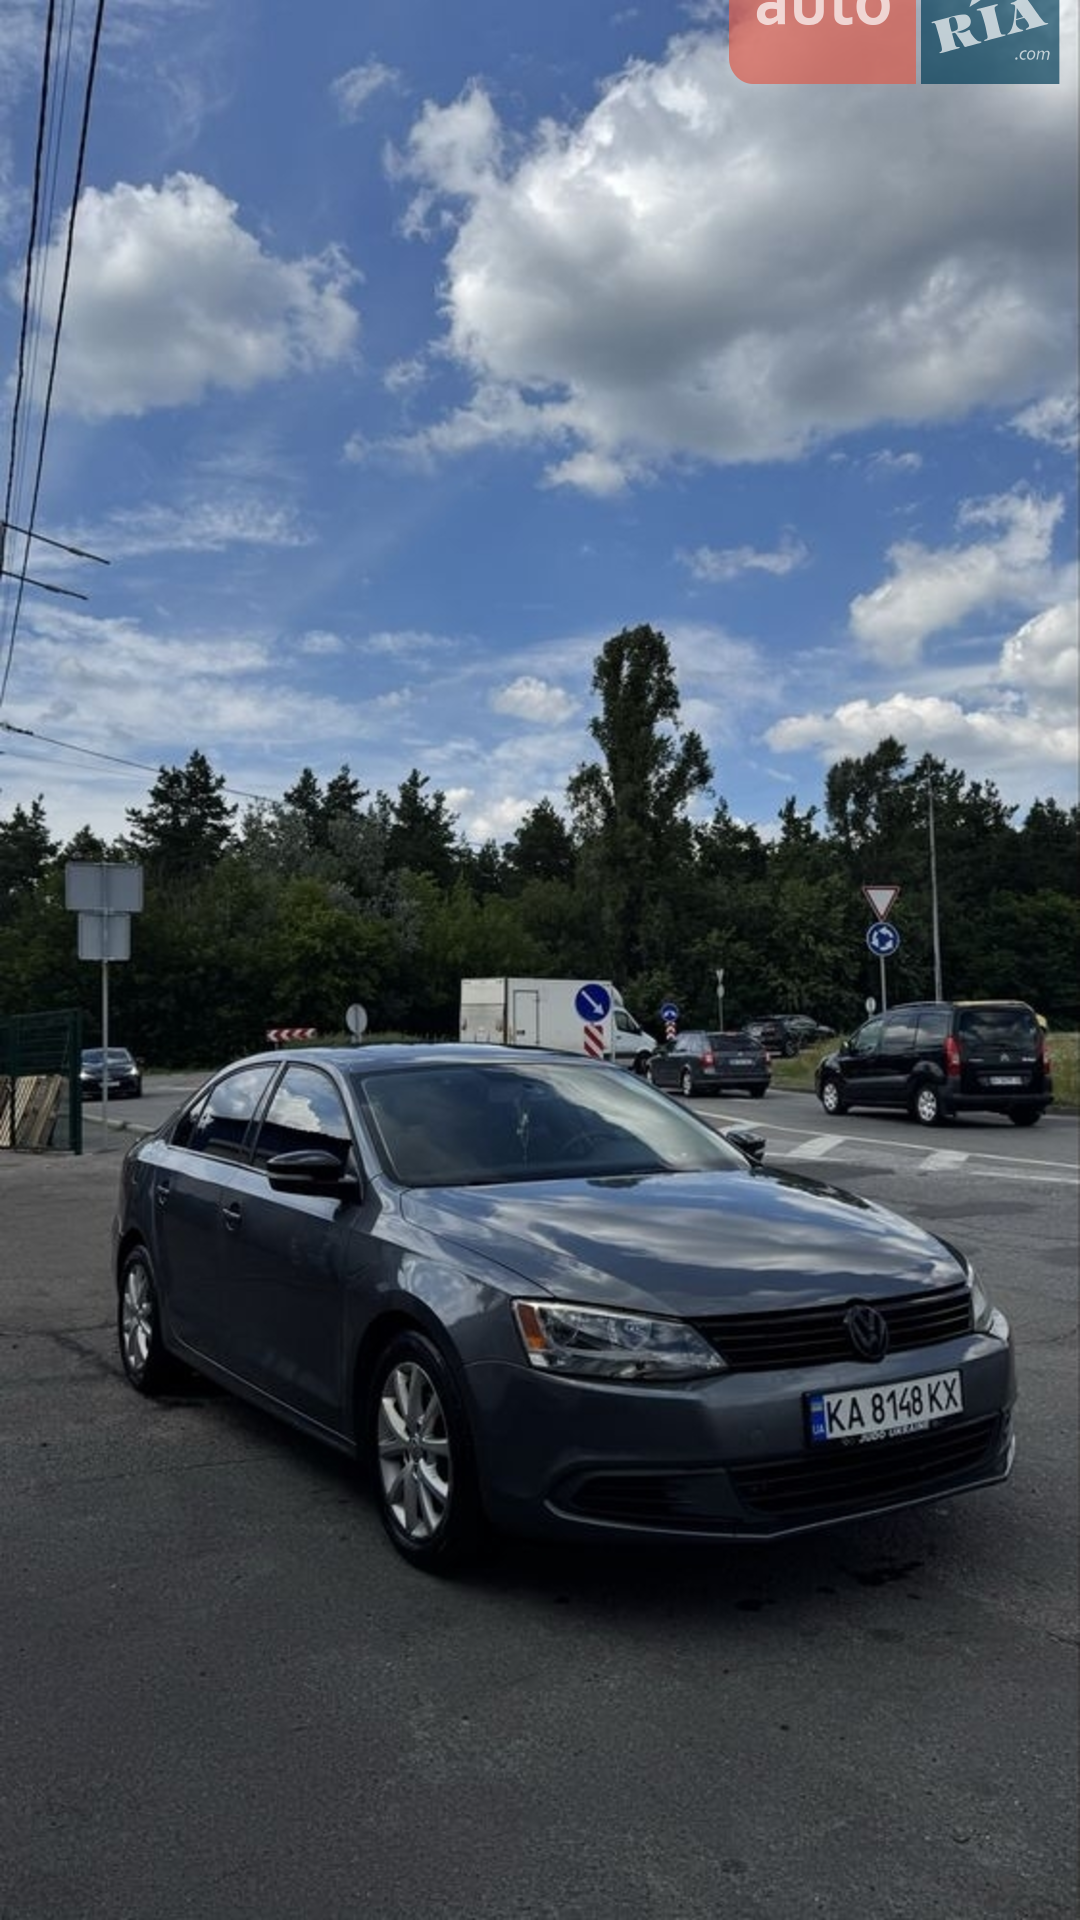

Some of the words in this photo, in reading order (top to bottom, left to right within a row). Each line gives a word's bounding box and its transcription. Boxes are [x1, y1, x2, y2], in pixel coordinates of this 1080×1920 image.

[827, 1397, 865, 1433] KA
[872, 1386, 923, 1424] 8148
[928, 1378, 958, 1412] KX
[812, 1424, 824, 1434] UA
